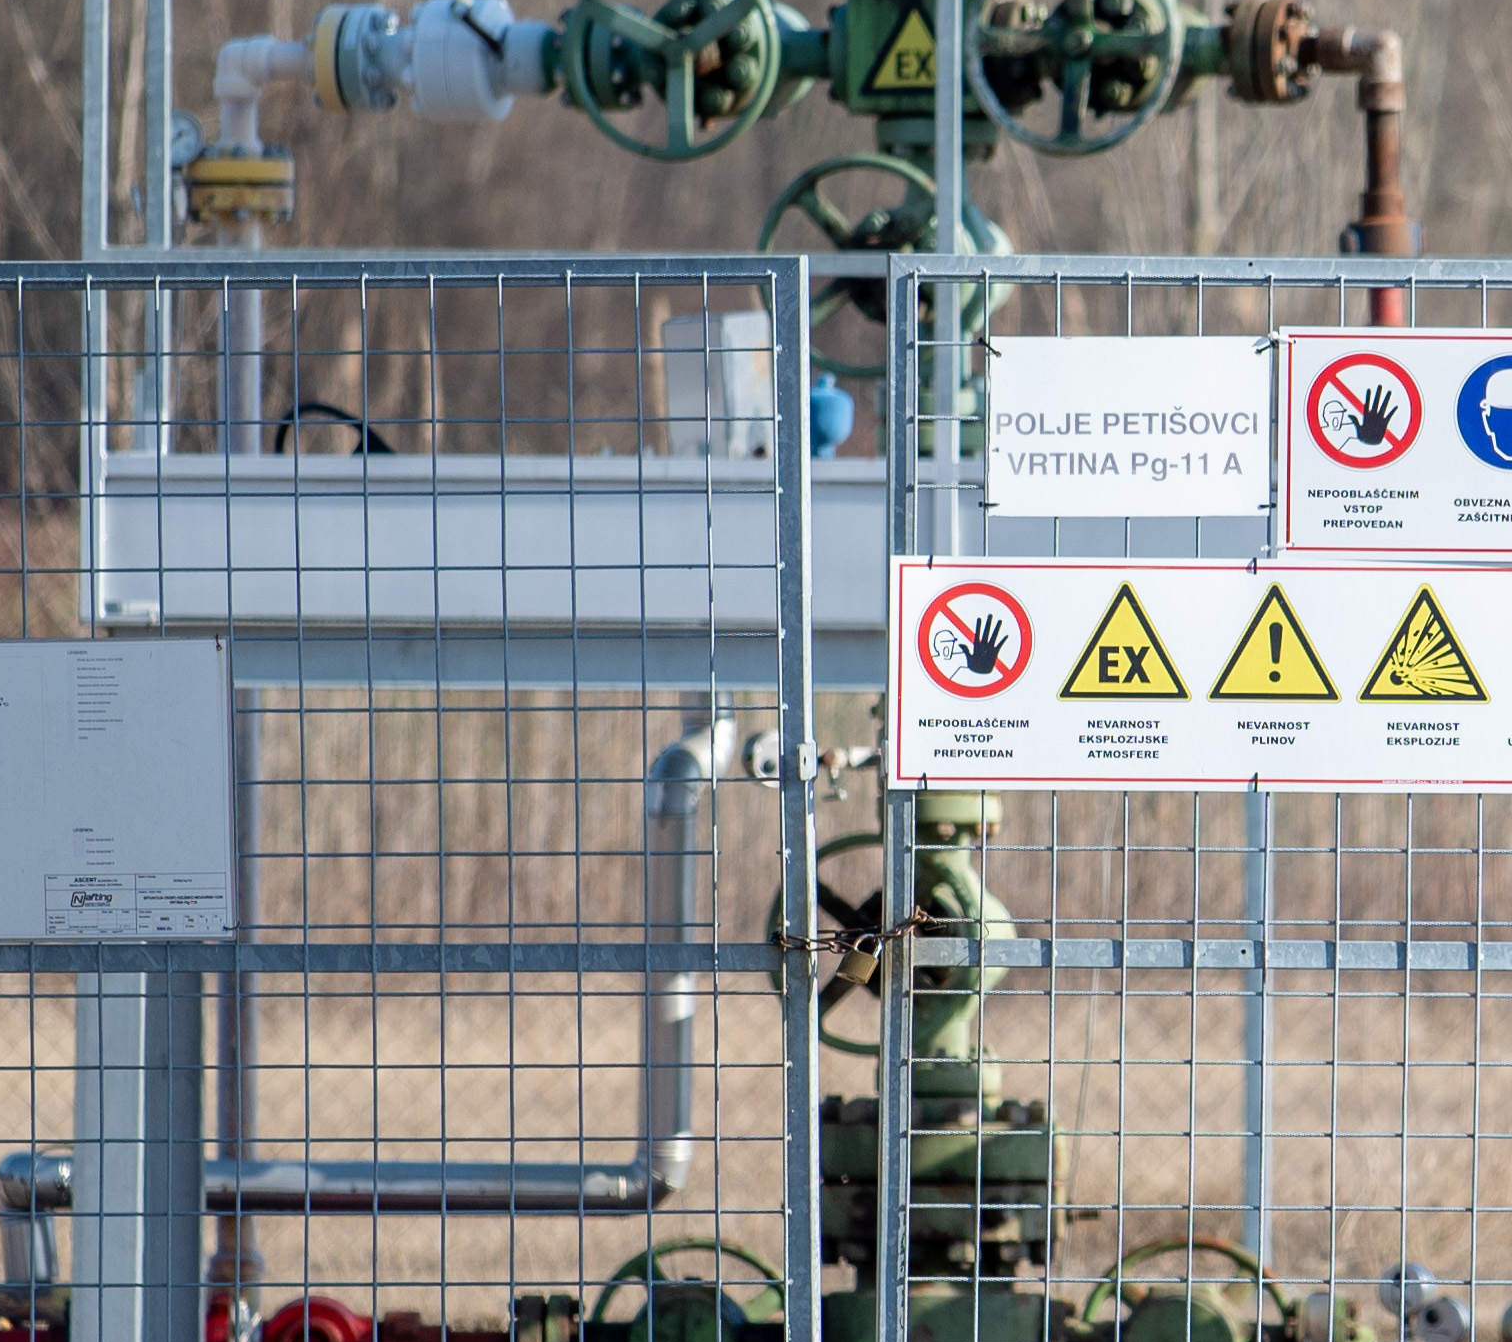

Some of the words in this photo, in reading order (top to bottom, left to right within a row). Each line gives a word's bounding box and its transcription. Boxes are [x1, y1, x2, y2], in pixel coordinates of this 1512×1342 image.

[896, 51, 933, 80] EX
[996, 412, 1092, 436] POLJE
[1103, 405, 1258, 435] PETIŠOVCI
[1007, 452, 1120, 476] VRTINA
[1131, 452, 1208, 482] Pg-11
[1222, 452, 1243, 475] A
[1307, 488, 1420, 499] NEPOOBLAŠČENIM
[1453, 498, 1511, 508] OBVEZNA
[1343, 504, 1383, 514] VSTOP
[1323, 519, 1403, 529] PREPOVEDAN
[1098, 645, 1152, 684] EX
[918, 717, 1030, 729] NEPOOBLAŠČENIM
[1087, 719, 1161, 730] NEVARNOST
[1237, 720, 1311, 731] NEVARNOST
[1387, 721, 1460, 732] NEVARNOST
[954, 733, 994, 743] VSTOP
[1078, 734, 1169, 745] EKSPLOZIJSKE
[1251, 735, 1296, 745] PLINOV
[1386, 736, 1460, 746] EKSPLOZIJE
[933, 748, 1014, 758] PREPOVEDAN
[1087, 749, 1160, 759] ATMOSFERE
